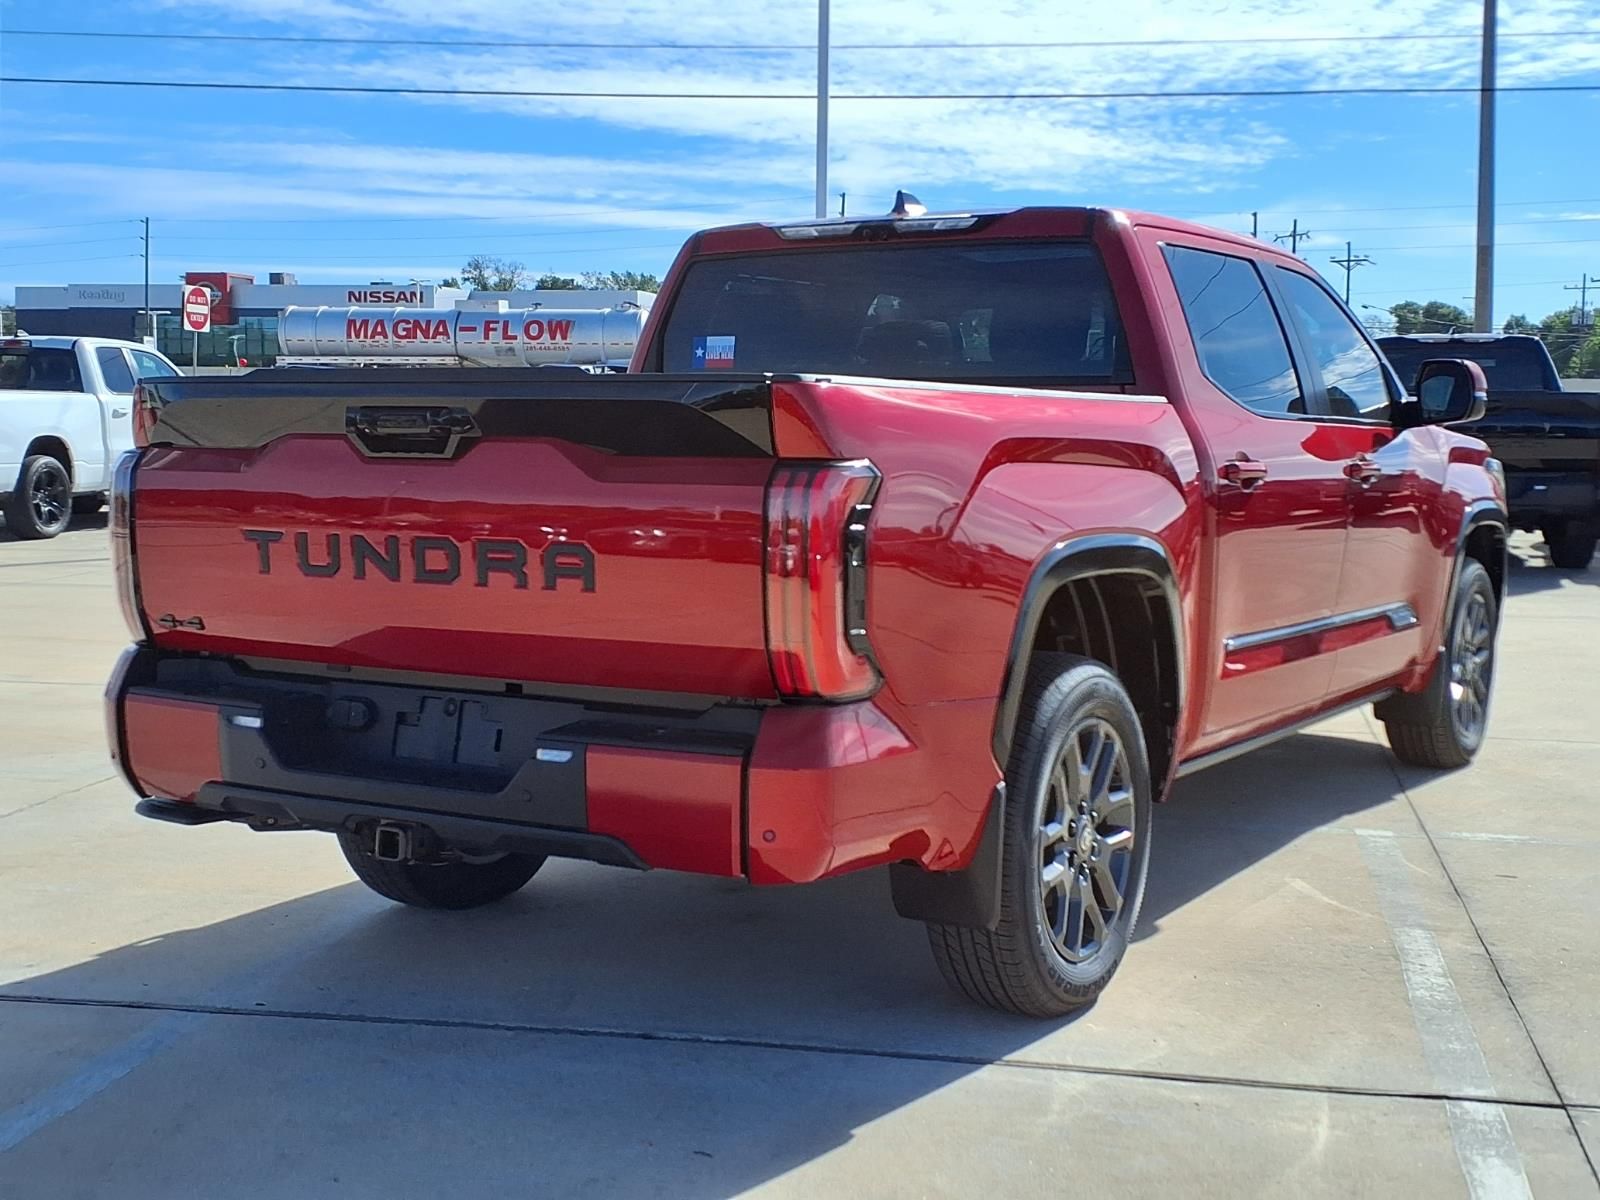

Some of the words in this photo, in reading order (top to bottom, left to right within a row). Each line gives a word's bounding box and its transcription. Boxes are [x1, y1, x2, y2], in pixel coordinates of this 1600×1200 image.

[189, 295, 197, 303] DO
[197, 296, 206, 304] NOT
[348, 290, 424, 304] NISSAN
[190, 314, 205, 323] ENTER
[241, 529, 596, 593] TUNDRA
